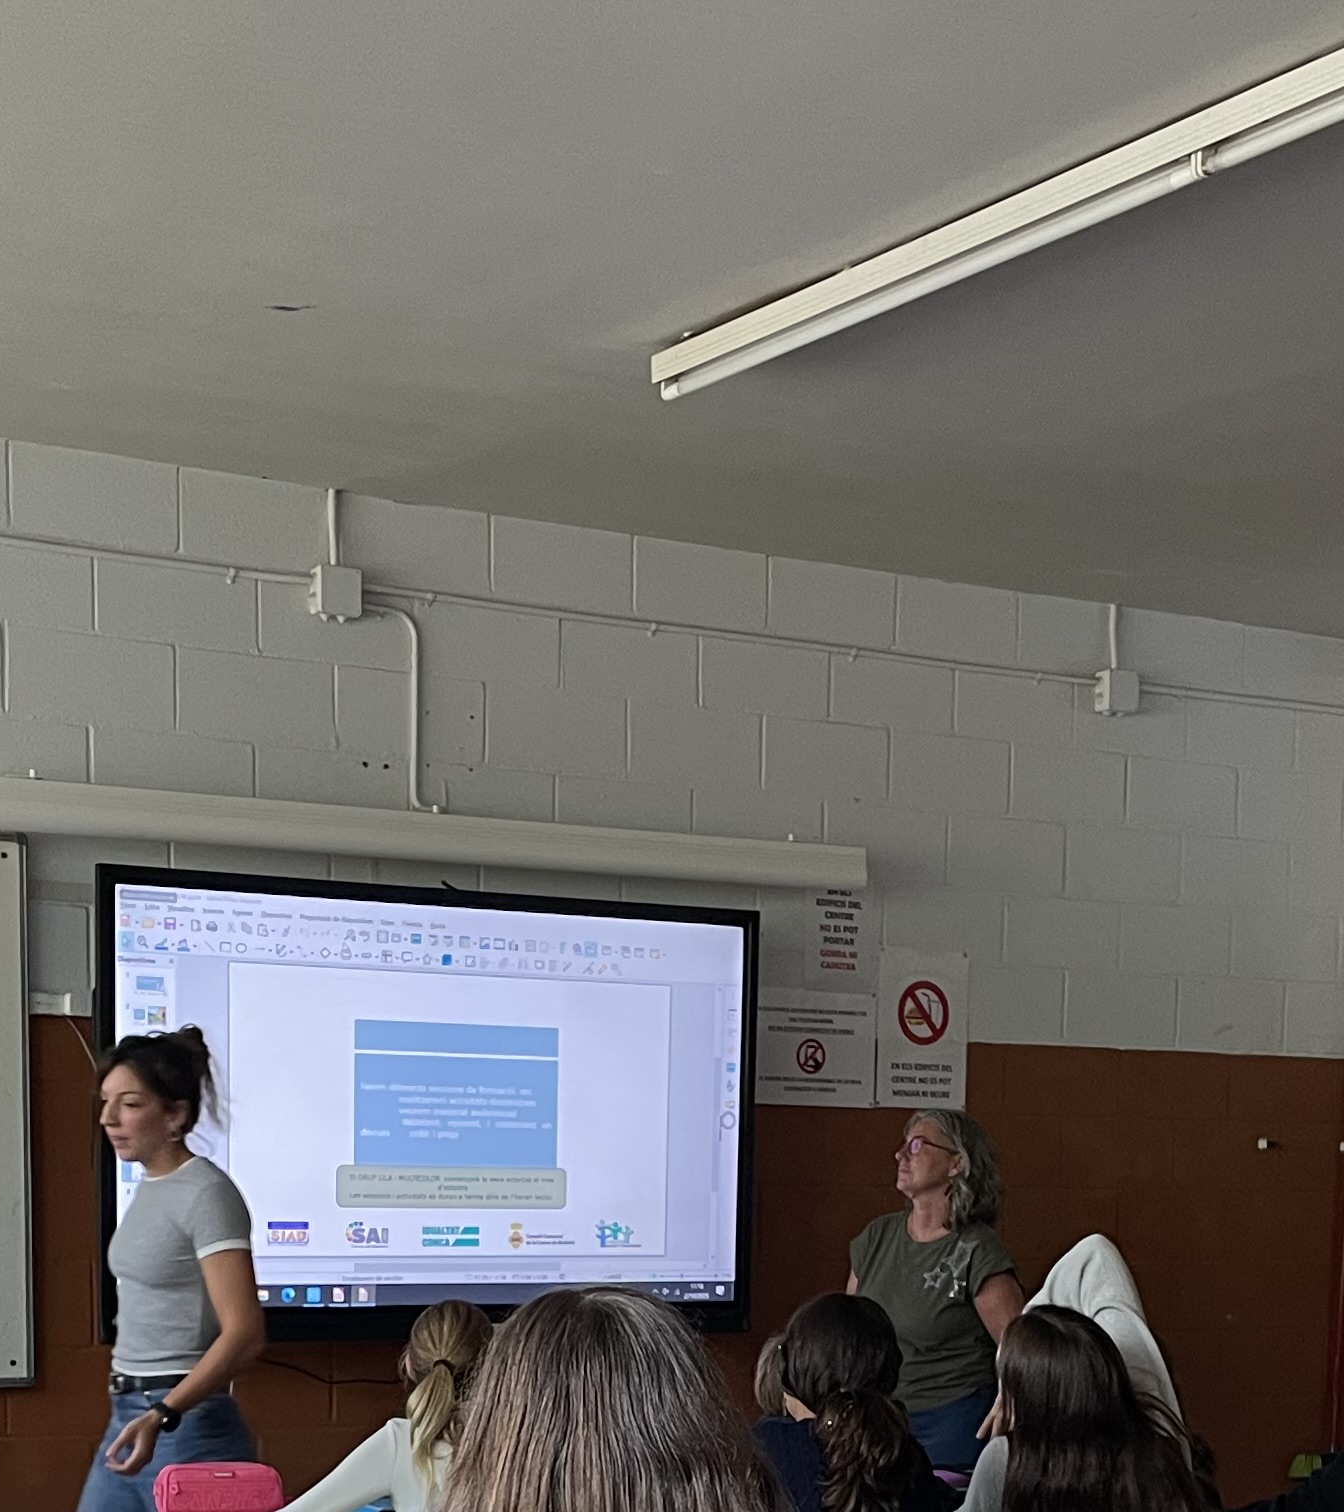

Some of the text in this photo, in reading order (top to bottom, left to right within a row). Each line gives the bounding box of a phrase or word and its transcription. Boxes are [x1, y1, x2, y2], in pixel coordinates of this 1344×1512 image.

[820, 924, 832, 933] NO
[843, 925, 859, 935] POT
[271, 1230, 307, 1243] SIAD
[352, 1228, 389, 1244] SAI
